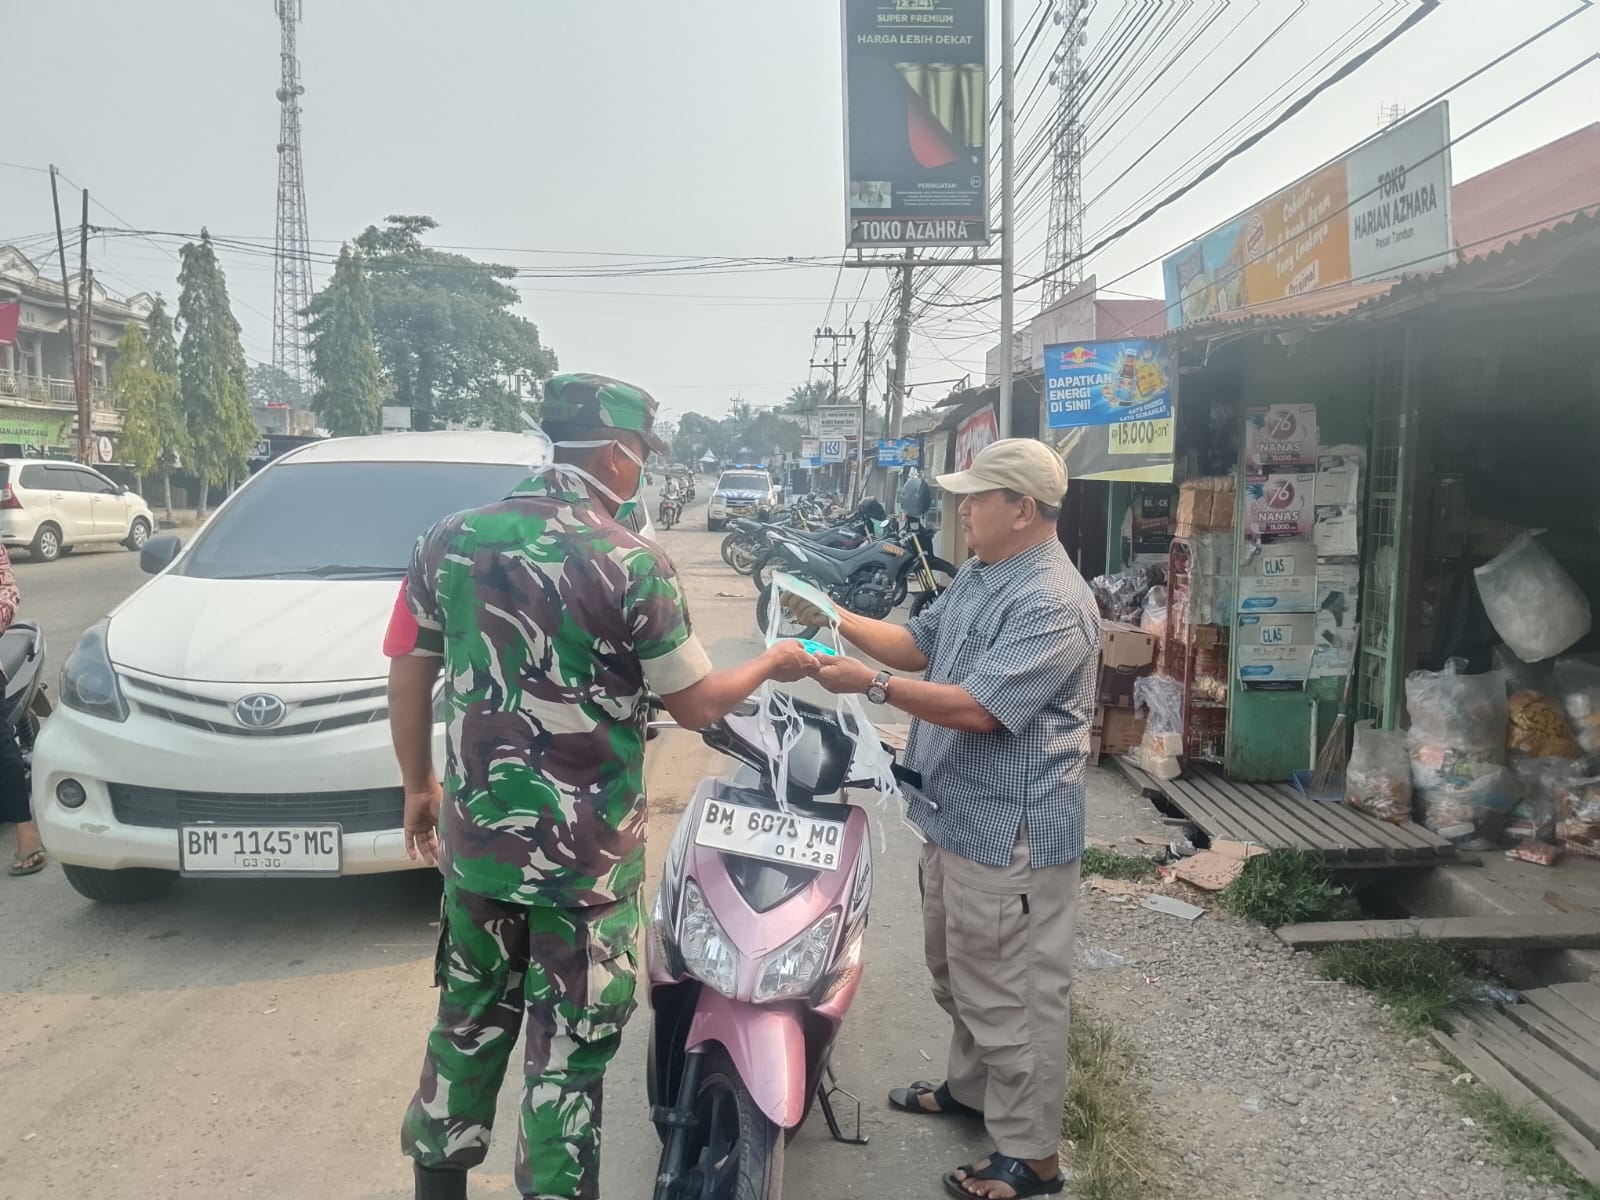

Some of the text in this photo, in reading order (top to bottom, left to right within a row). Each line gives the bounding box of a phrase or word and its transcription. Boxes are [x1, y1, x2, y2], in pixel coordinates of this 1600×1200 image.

[877, 14, 953, 23] SUPER PREMIUM
[857, 34, 973, 45] HARGA LEBIH DEKAT
[1378, 164, 1406, 200] TOKO
[1354, 183, 1437, 240] HARIAN AZHARA
[861, 219, 968, 240] TOKO AZAHRA
[1048, 373, 1112, 389] DAPATKAN
[1049, 387, 1090, 401] ENERGI
[1050, 401, 1063, 413] DI
[1260, 441, 1301, 452] NANAS
[1269, 480, 1289, 507] 76
[1258, 511, 1299, 521] NANAS
[1264, 559, 1285, 574] CLAS
[1262, 627, 1283, 643] CLAS
[706, 803, 735, 825] BM
[810, 824, 839, 846] MQ
[188, 831, 334, 855] BM 1145 MC
